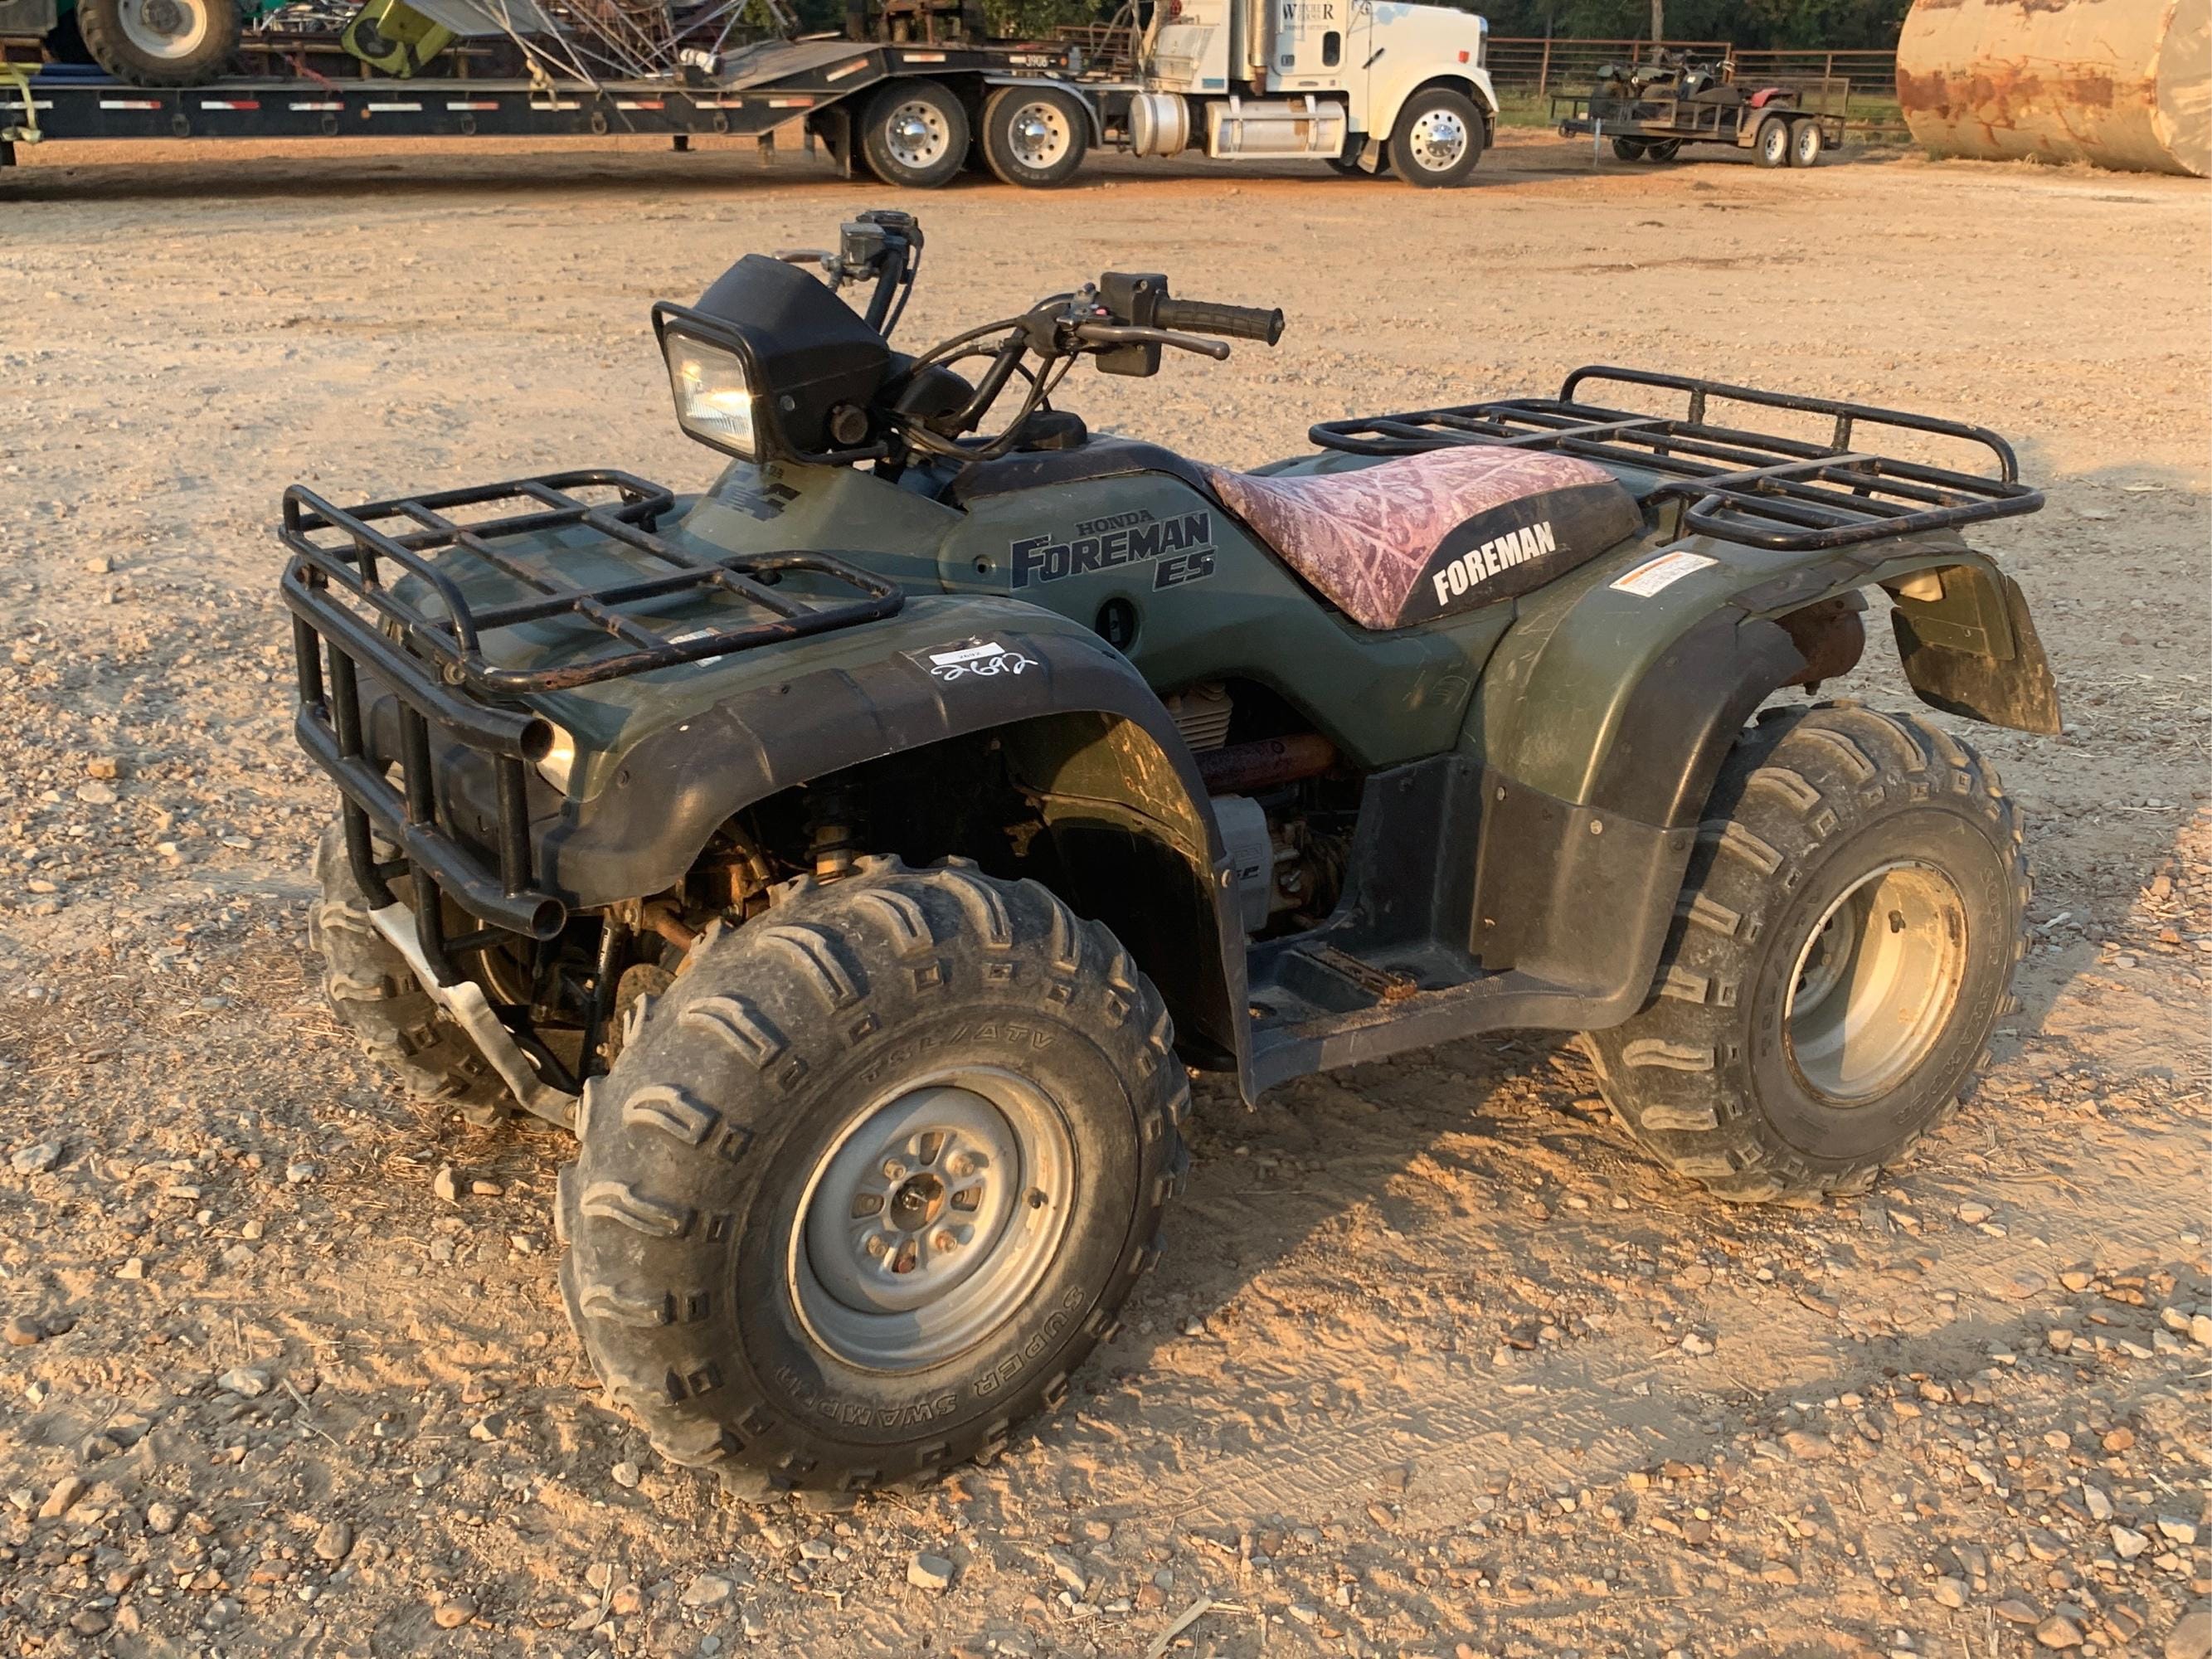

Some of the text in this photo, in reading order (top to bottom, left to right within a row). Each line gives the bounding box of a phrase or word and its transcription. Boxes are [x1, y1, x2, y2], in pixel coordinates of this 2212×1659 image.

[1010, 509, 1213, 591] FOREMAN
[1076, 508, 1155, 536] HONDA
[1152, 545, 1218, 591] ES
[1432, 521, 1556, 606] FOREMAN
[974, 1286, 1087, 1397] SUPER
